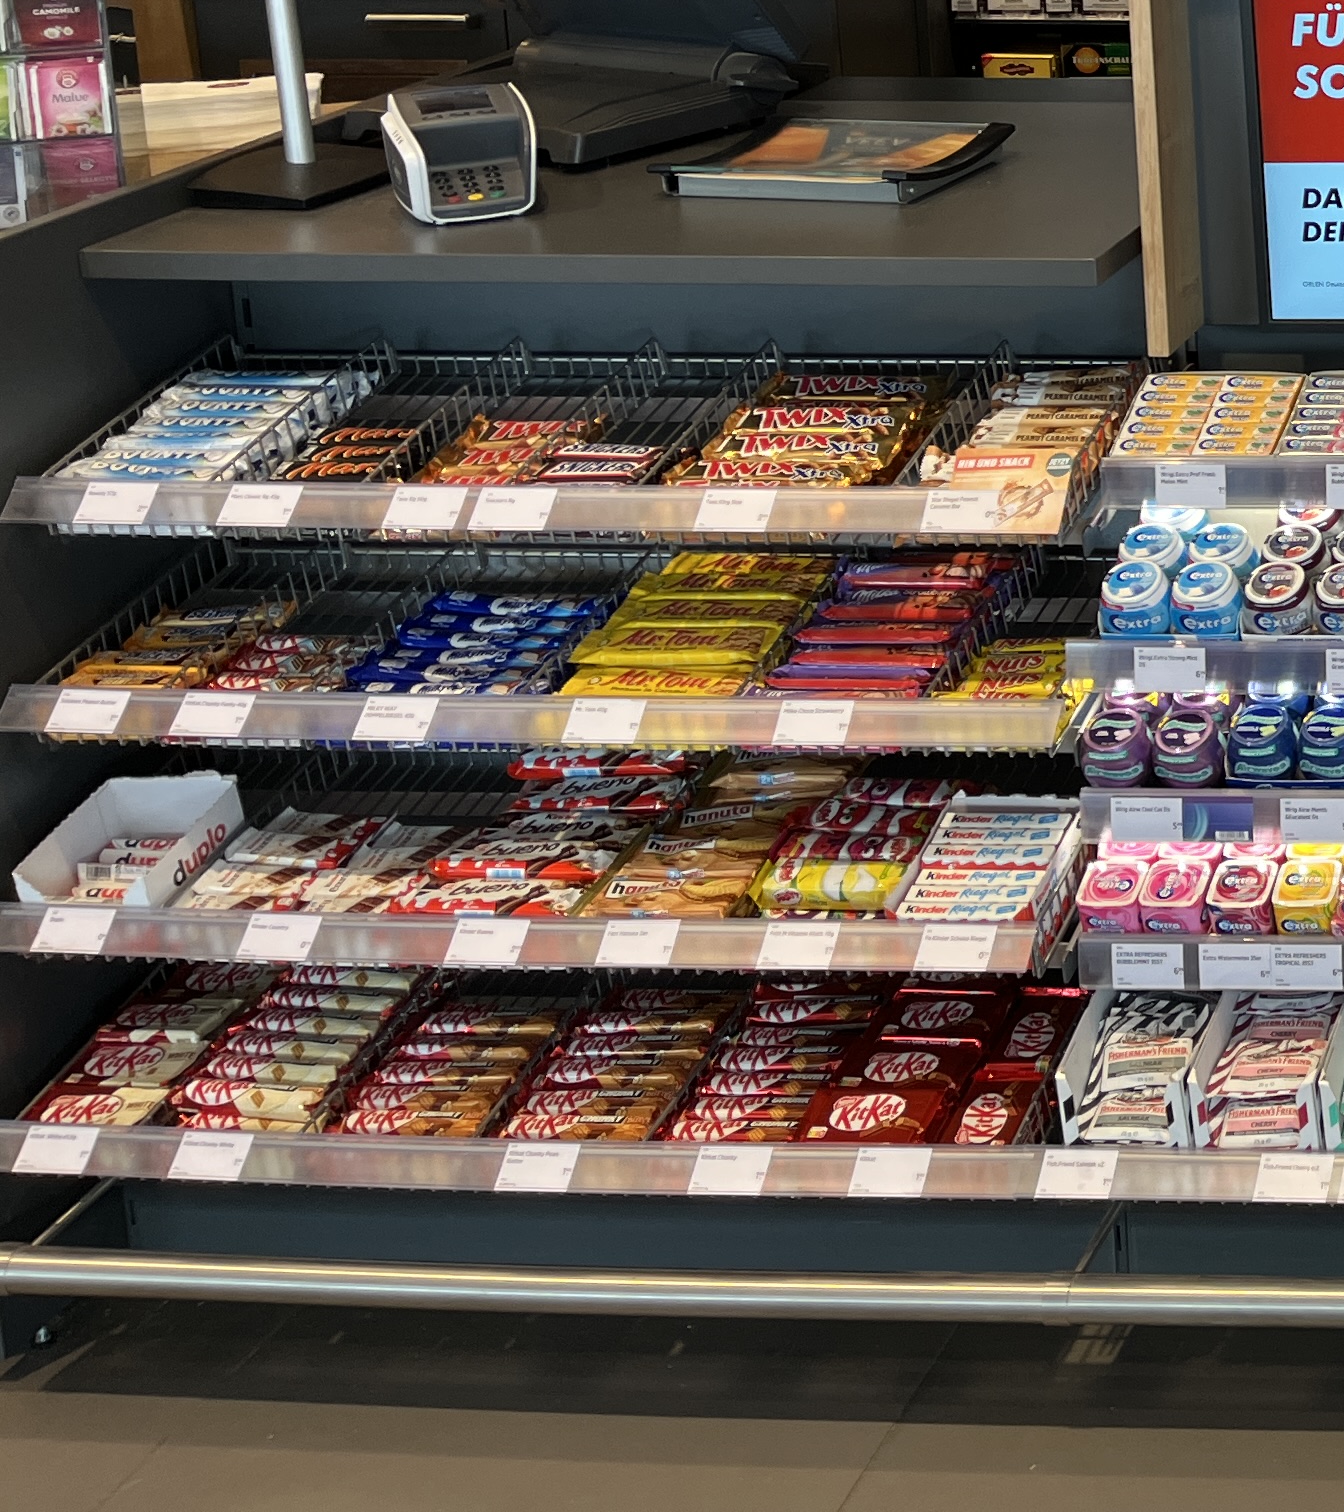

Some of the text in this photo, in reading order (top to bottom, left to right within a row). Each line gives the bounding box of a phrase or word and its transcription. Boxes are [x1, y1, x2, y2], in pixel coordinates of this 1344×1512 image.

[33, 7, 80, 16] CAMOMILE
[1113, 614, 1164, 631] extra
[683, 804, 753, 826] hanuta
[906, 905, 947, 918] kinder
[831, 1100, 903, 1130] KitKat
